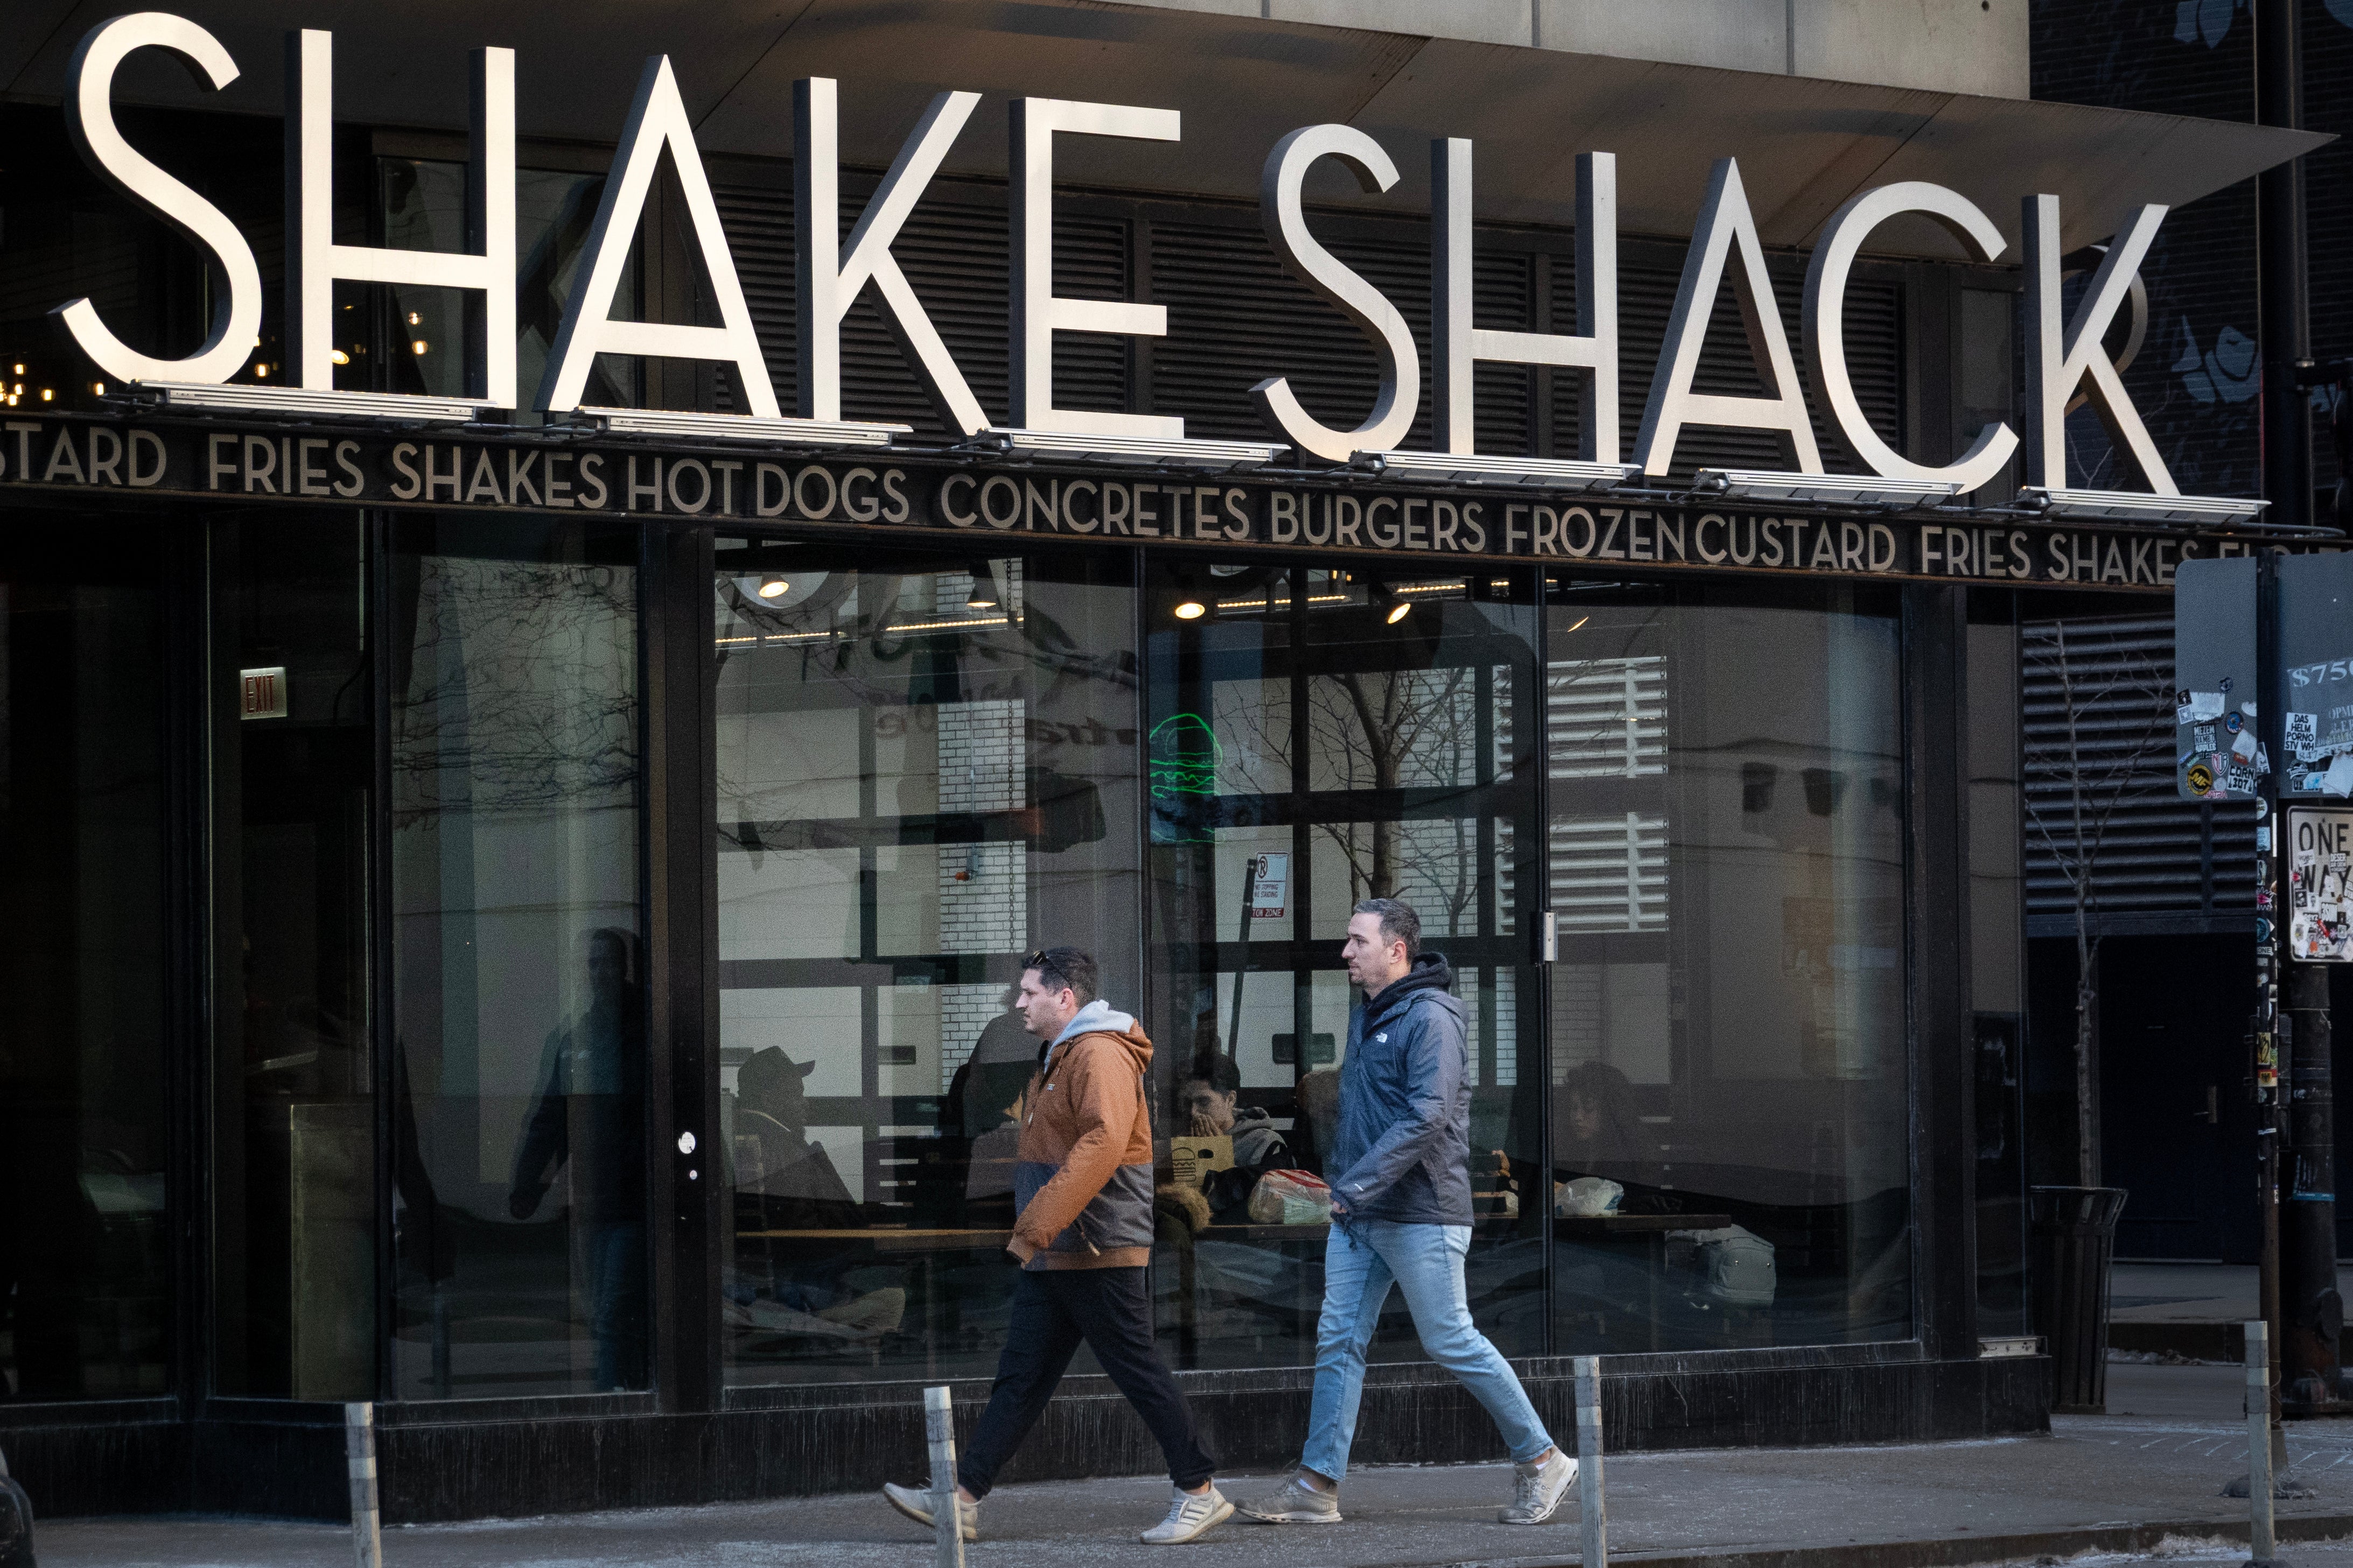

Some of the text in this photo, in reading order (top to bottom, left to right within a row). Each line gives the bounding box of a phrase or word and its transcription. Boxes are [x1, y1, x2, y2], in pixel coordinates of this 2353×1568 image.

[60, 11, 1185, 440] SHAKE
[1249, 123, 2177, 496] SHACK
[0, 422, 167, 487] TARD
[208, 433, 365, 497] FRIES
[390, 442, 607, 509] SHAKES
[628, 455, 744, 515] HOT
[757, 462, 909, 523] DOGS
[941, 473, 1250, 540] CONCRETES
[1271, 491, 1486, 553] BURGERS
[1506, 503, 1685, 561] FROZEN
[1695, 514, 1896, 572] CUSTARD
[1922, 526, 2031, 579] FRIES
[244, 673, 275, 714] EXIT
[2294, 714, 2309, 723] DAS
[2291, 723, 2311, 733] HELM
[2286, 732, 2314, 742] PORNO
[2285, 741, 2299, 750] STV
[2229, 765, 2254, 779] CORN
[2299, 821, 2351, 856] ONE
[2298, 864, 2352, 897] WAY
[1252, 909, 1281, 917] TOW ZONE
